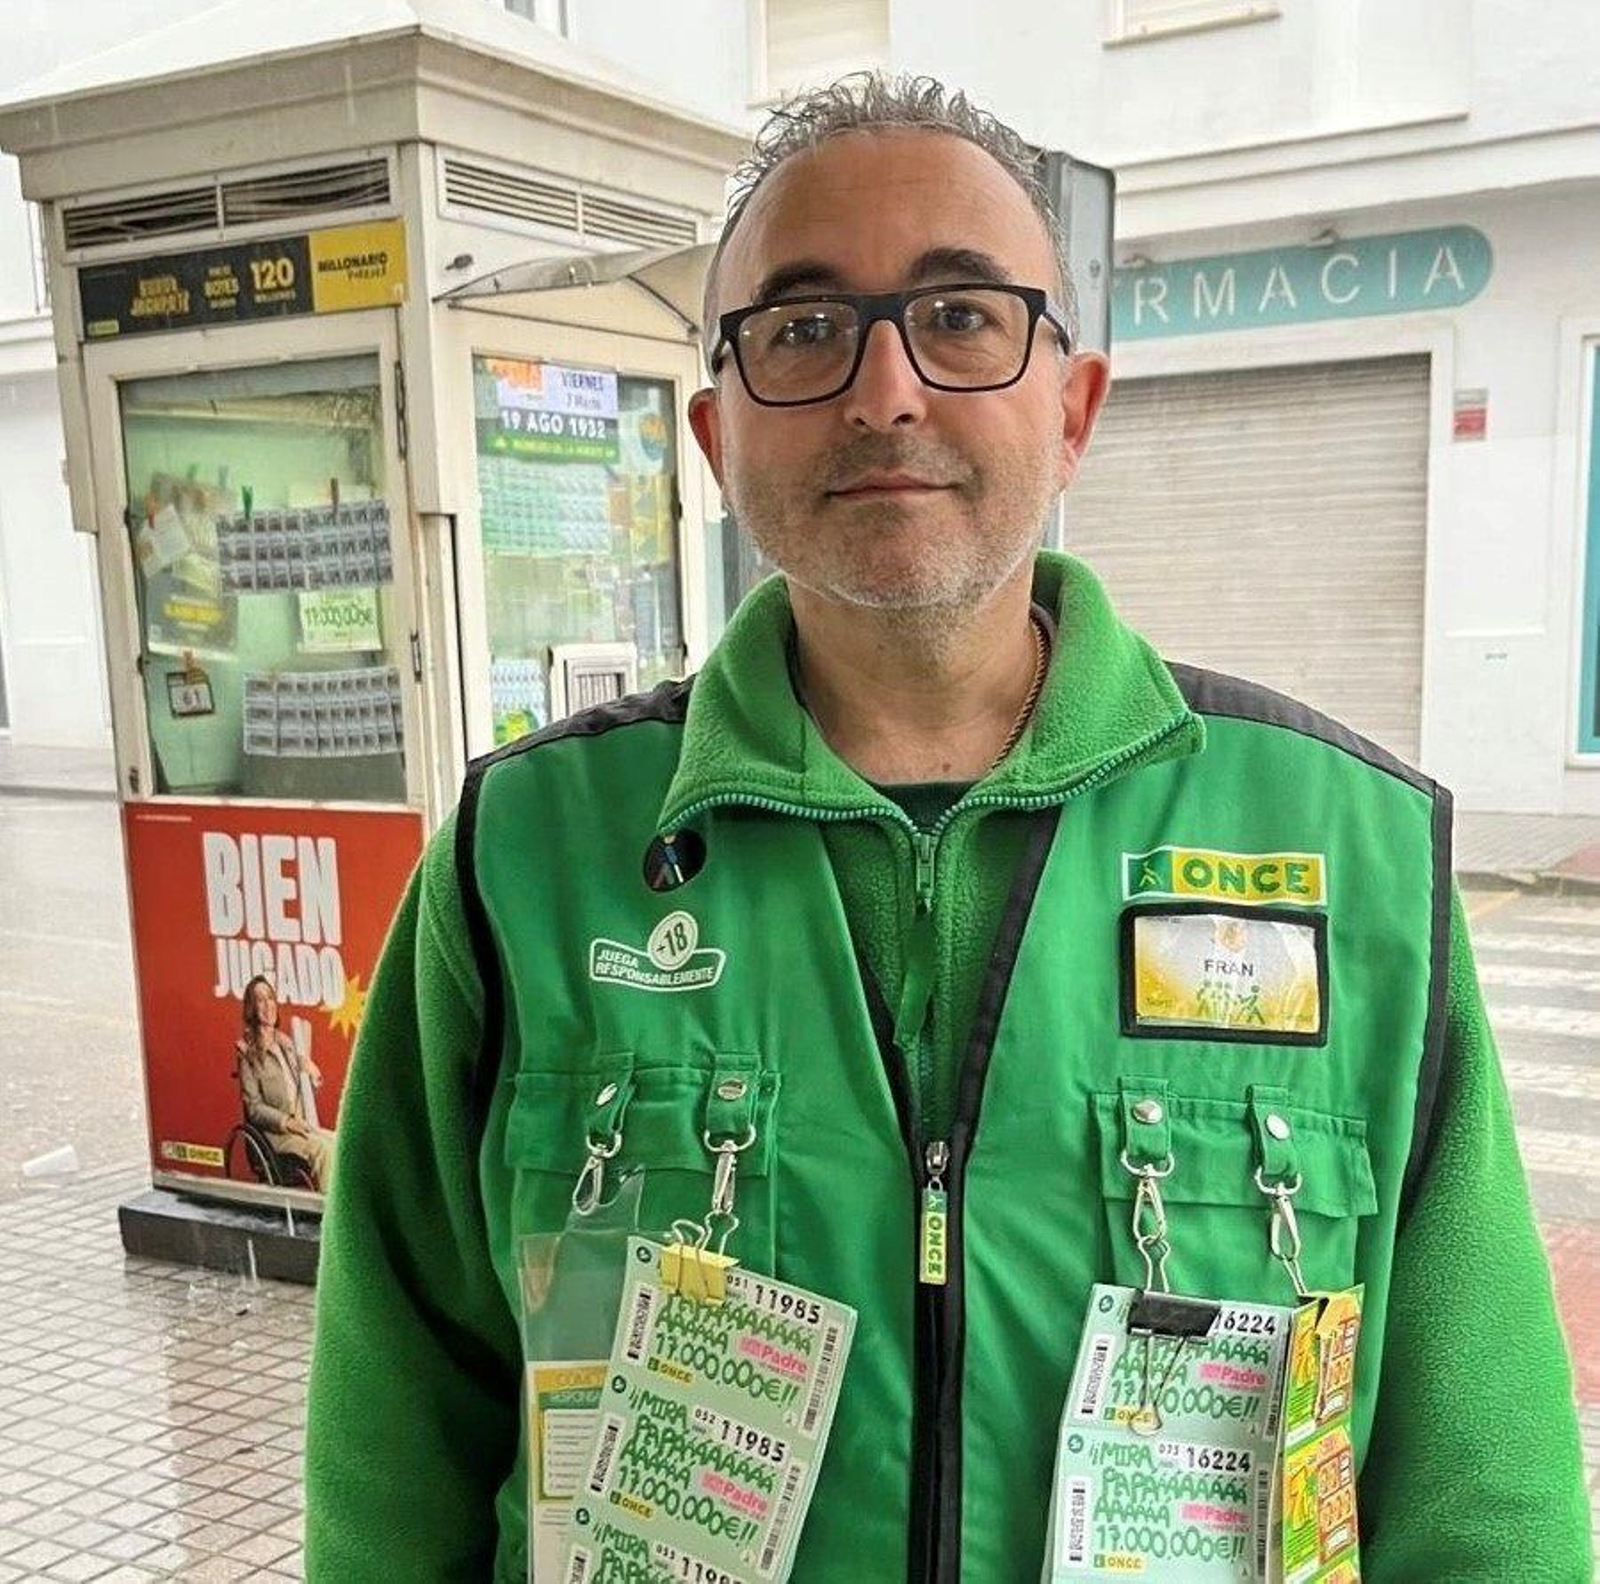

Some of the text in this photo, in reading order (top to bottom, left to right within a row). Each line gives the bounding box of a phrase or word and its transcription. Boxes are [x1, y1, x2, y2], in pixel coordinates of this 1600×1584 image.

[251, 257, 294, 290] 120
[1134, 246, 1465, 326] RMACIA
[501, 409, 606, 439] 19 AGO 1932
[202, 831, 342, 947] BIEN
[1182, 858, 1311, 894] ONCE
[214, 937, 346, 1009] JUGADO
[595, 962, 715, 986] RESPONSABLEMENTE
[597, 949, 640, 969] JUEGA
[1204, 959, 1254, 977] FRAN
[928, 1216, 944, 1275] ONCE
[754, 1284, 821, 1325] 11985
[661, 1363, 693, 1384] ONCE
[695, 1408, 717, 1424] 052
[721, 1420, 786, 1462] 11985
[1187, 1447, 1251, 1473] 16224
[682, 1556, 742, 1584] 119
[1107, 1556, 1143, 1569] ONCE
